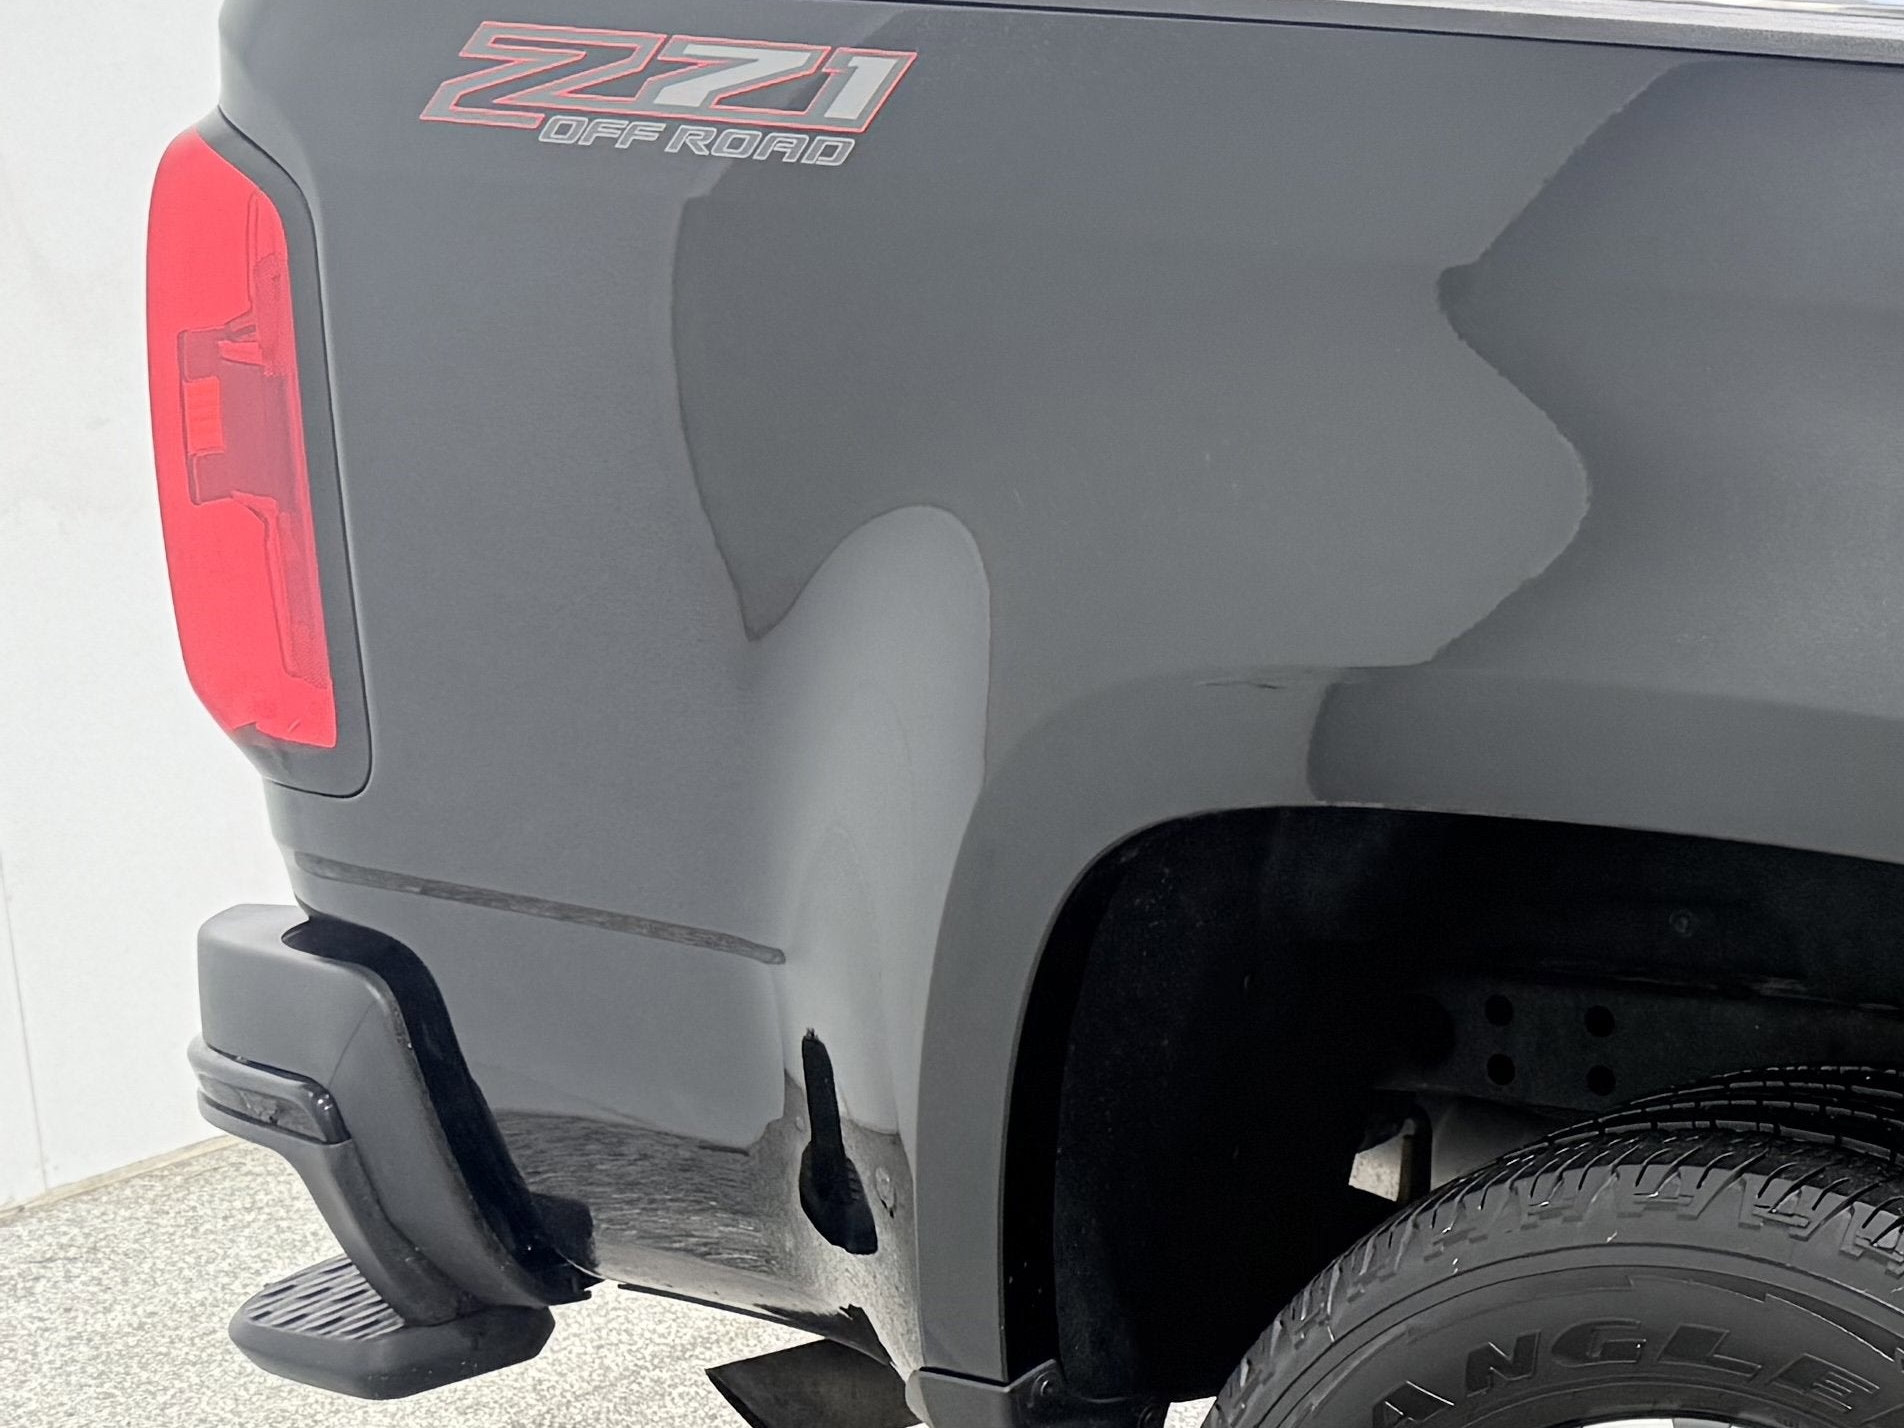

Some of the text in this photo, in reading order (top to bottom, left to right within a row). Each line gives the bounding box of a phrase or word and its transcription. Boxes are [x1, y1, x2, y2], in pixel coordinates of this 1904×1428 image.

[420, 20, 918, 134] Z71
[538, 115, 857, 167] OFF ROAD
